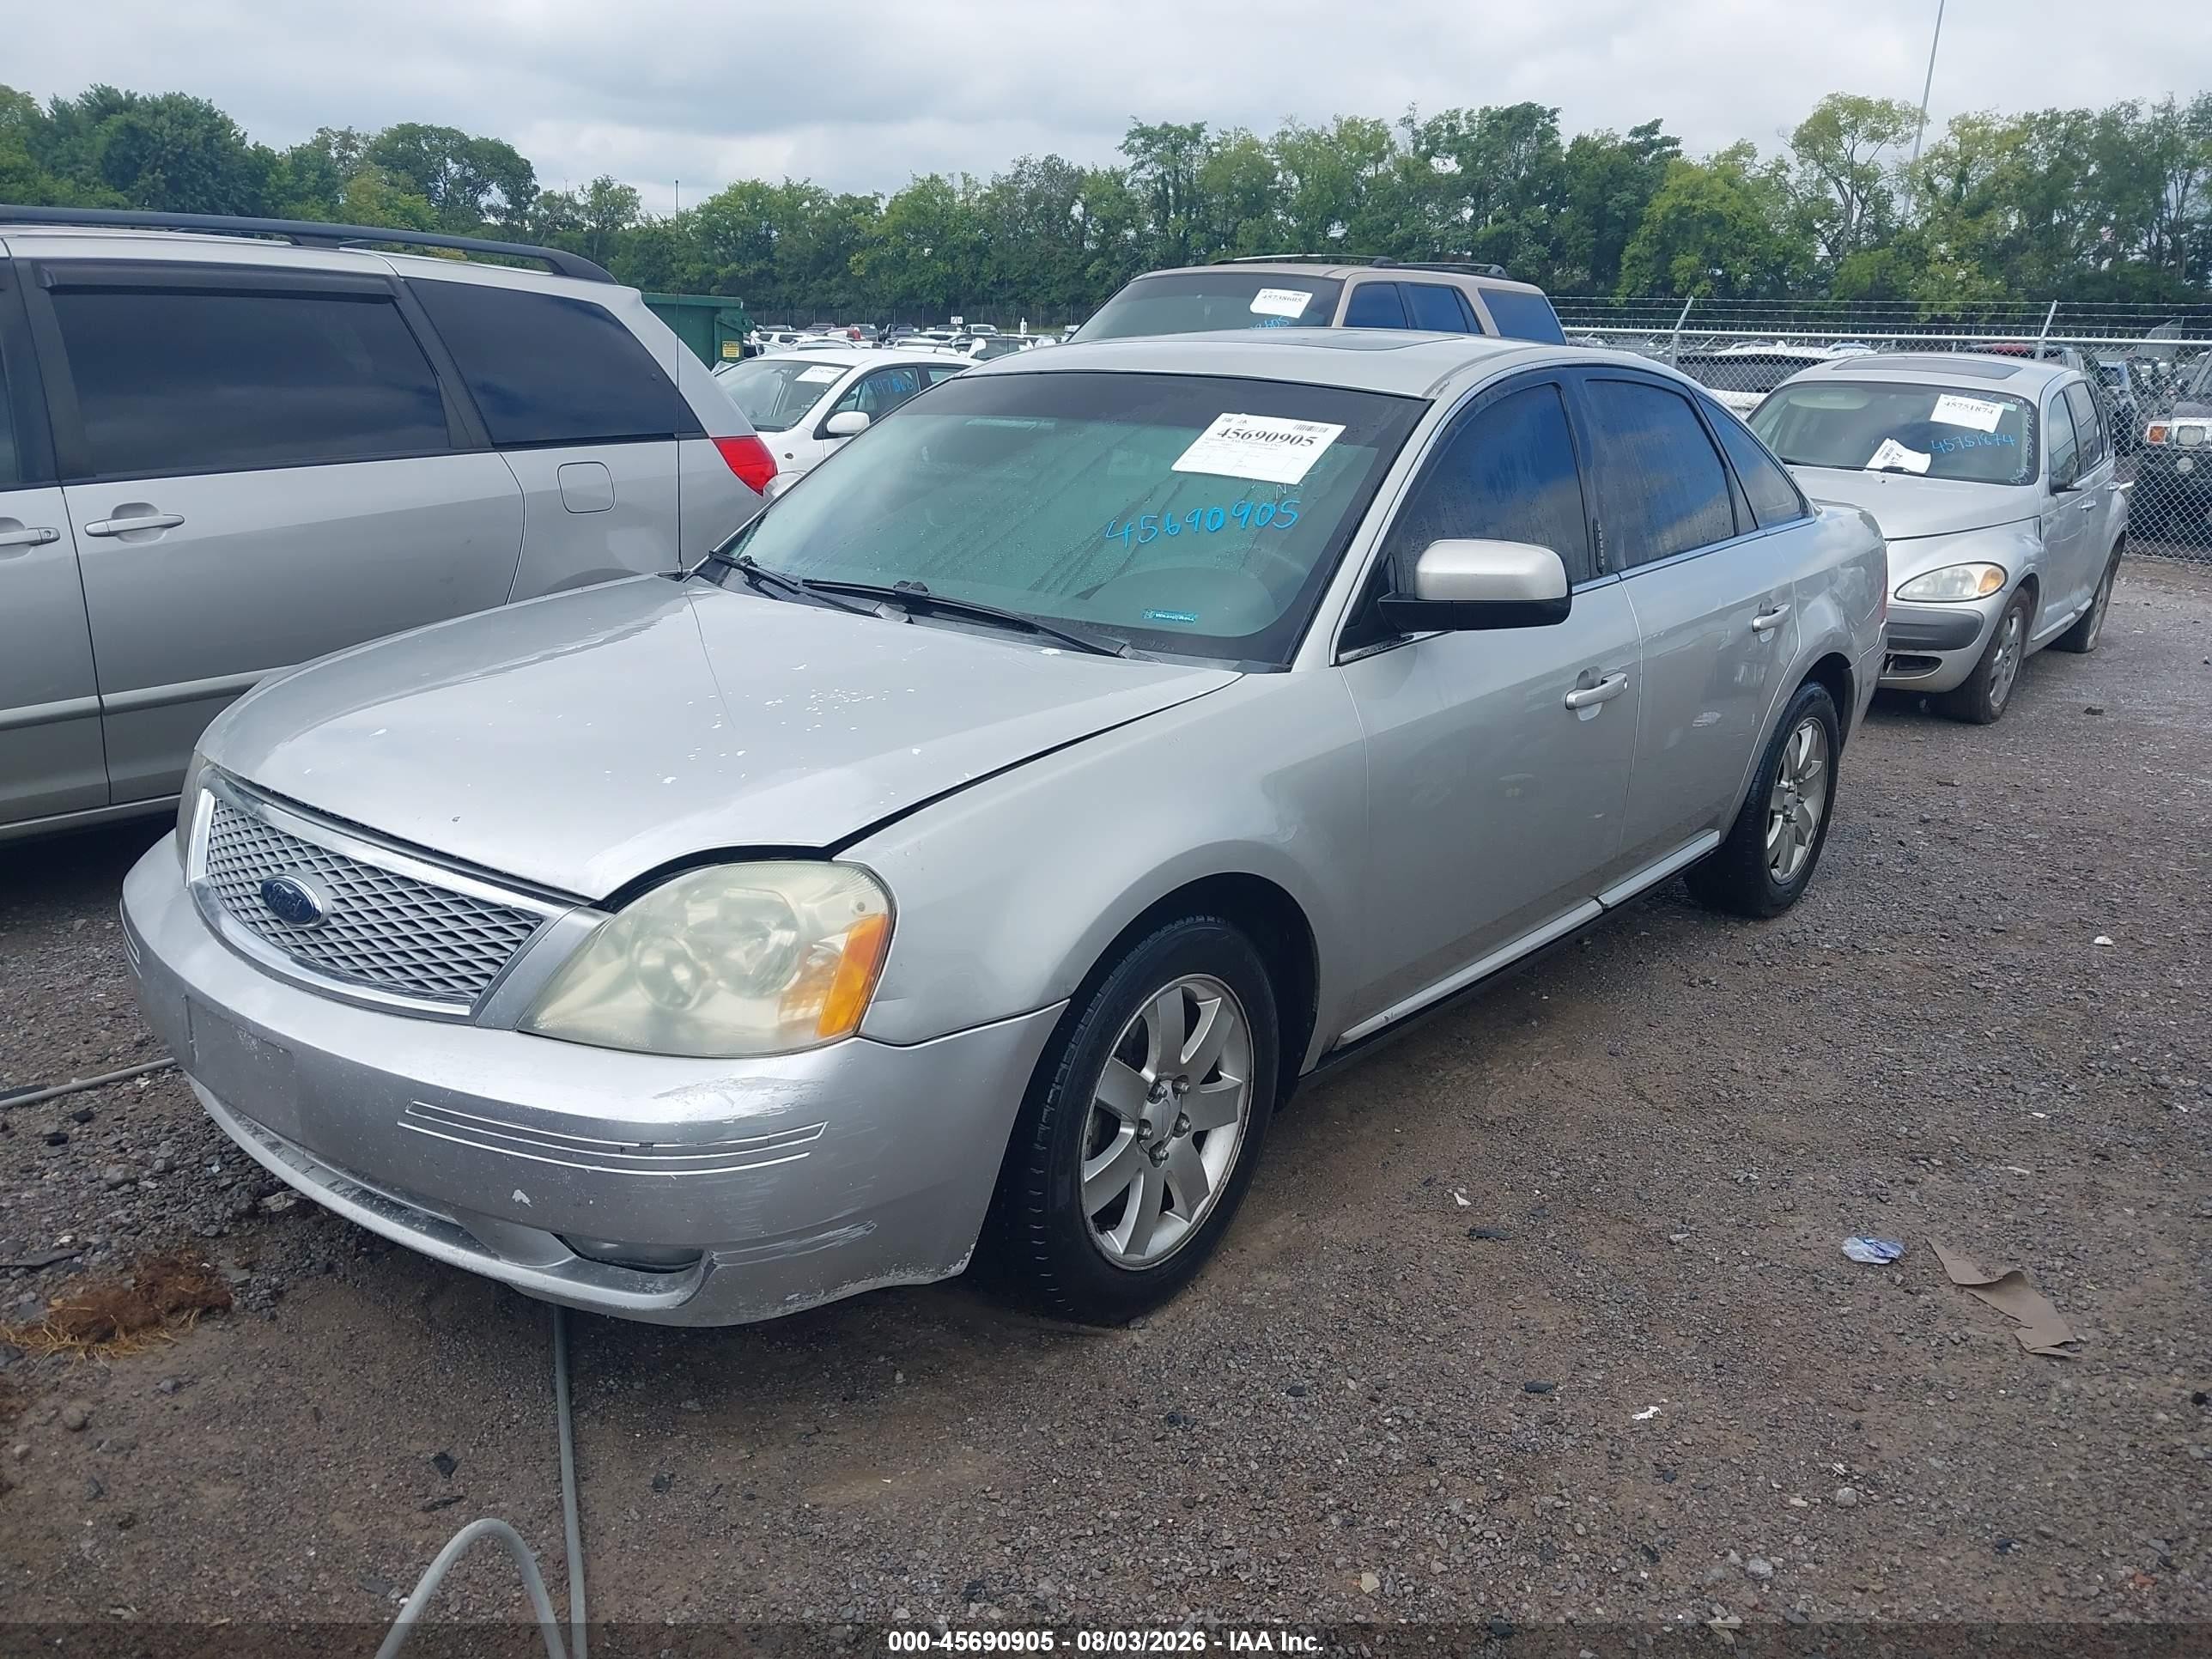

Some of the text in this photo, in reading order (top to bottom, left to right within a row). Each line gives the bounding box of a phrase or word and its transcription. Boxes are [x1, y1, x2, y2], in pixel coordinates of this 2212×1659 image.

[1217, 428, 1319, 447] 45690905
[1930, 433, 2016, 454] 45751874
[1105, 500, 1302, 549] 45690905
